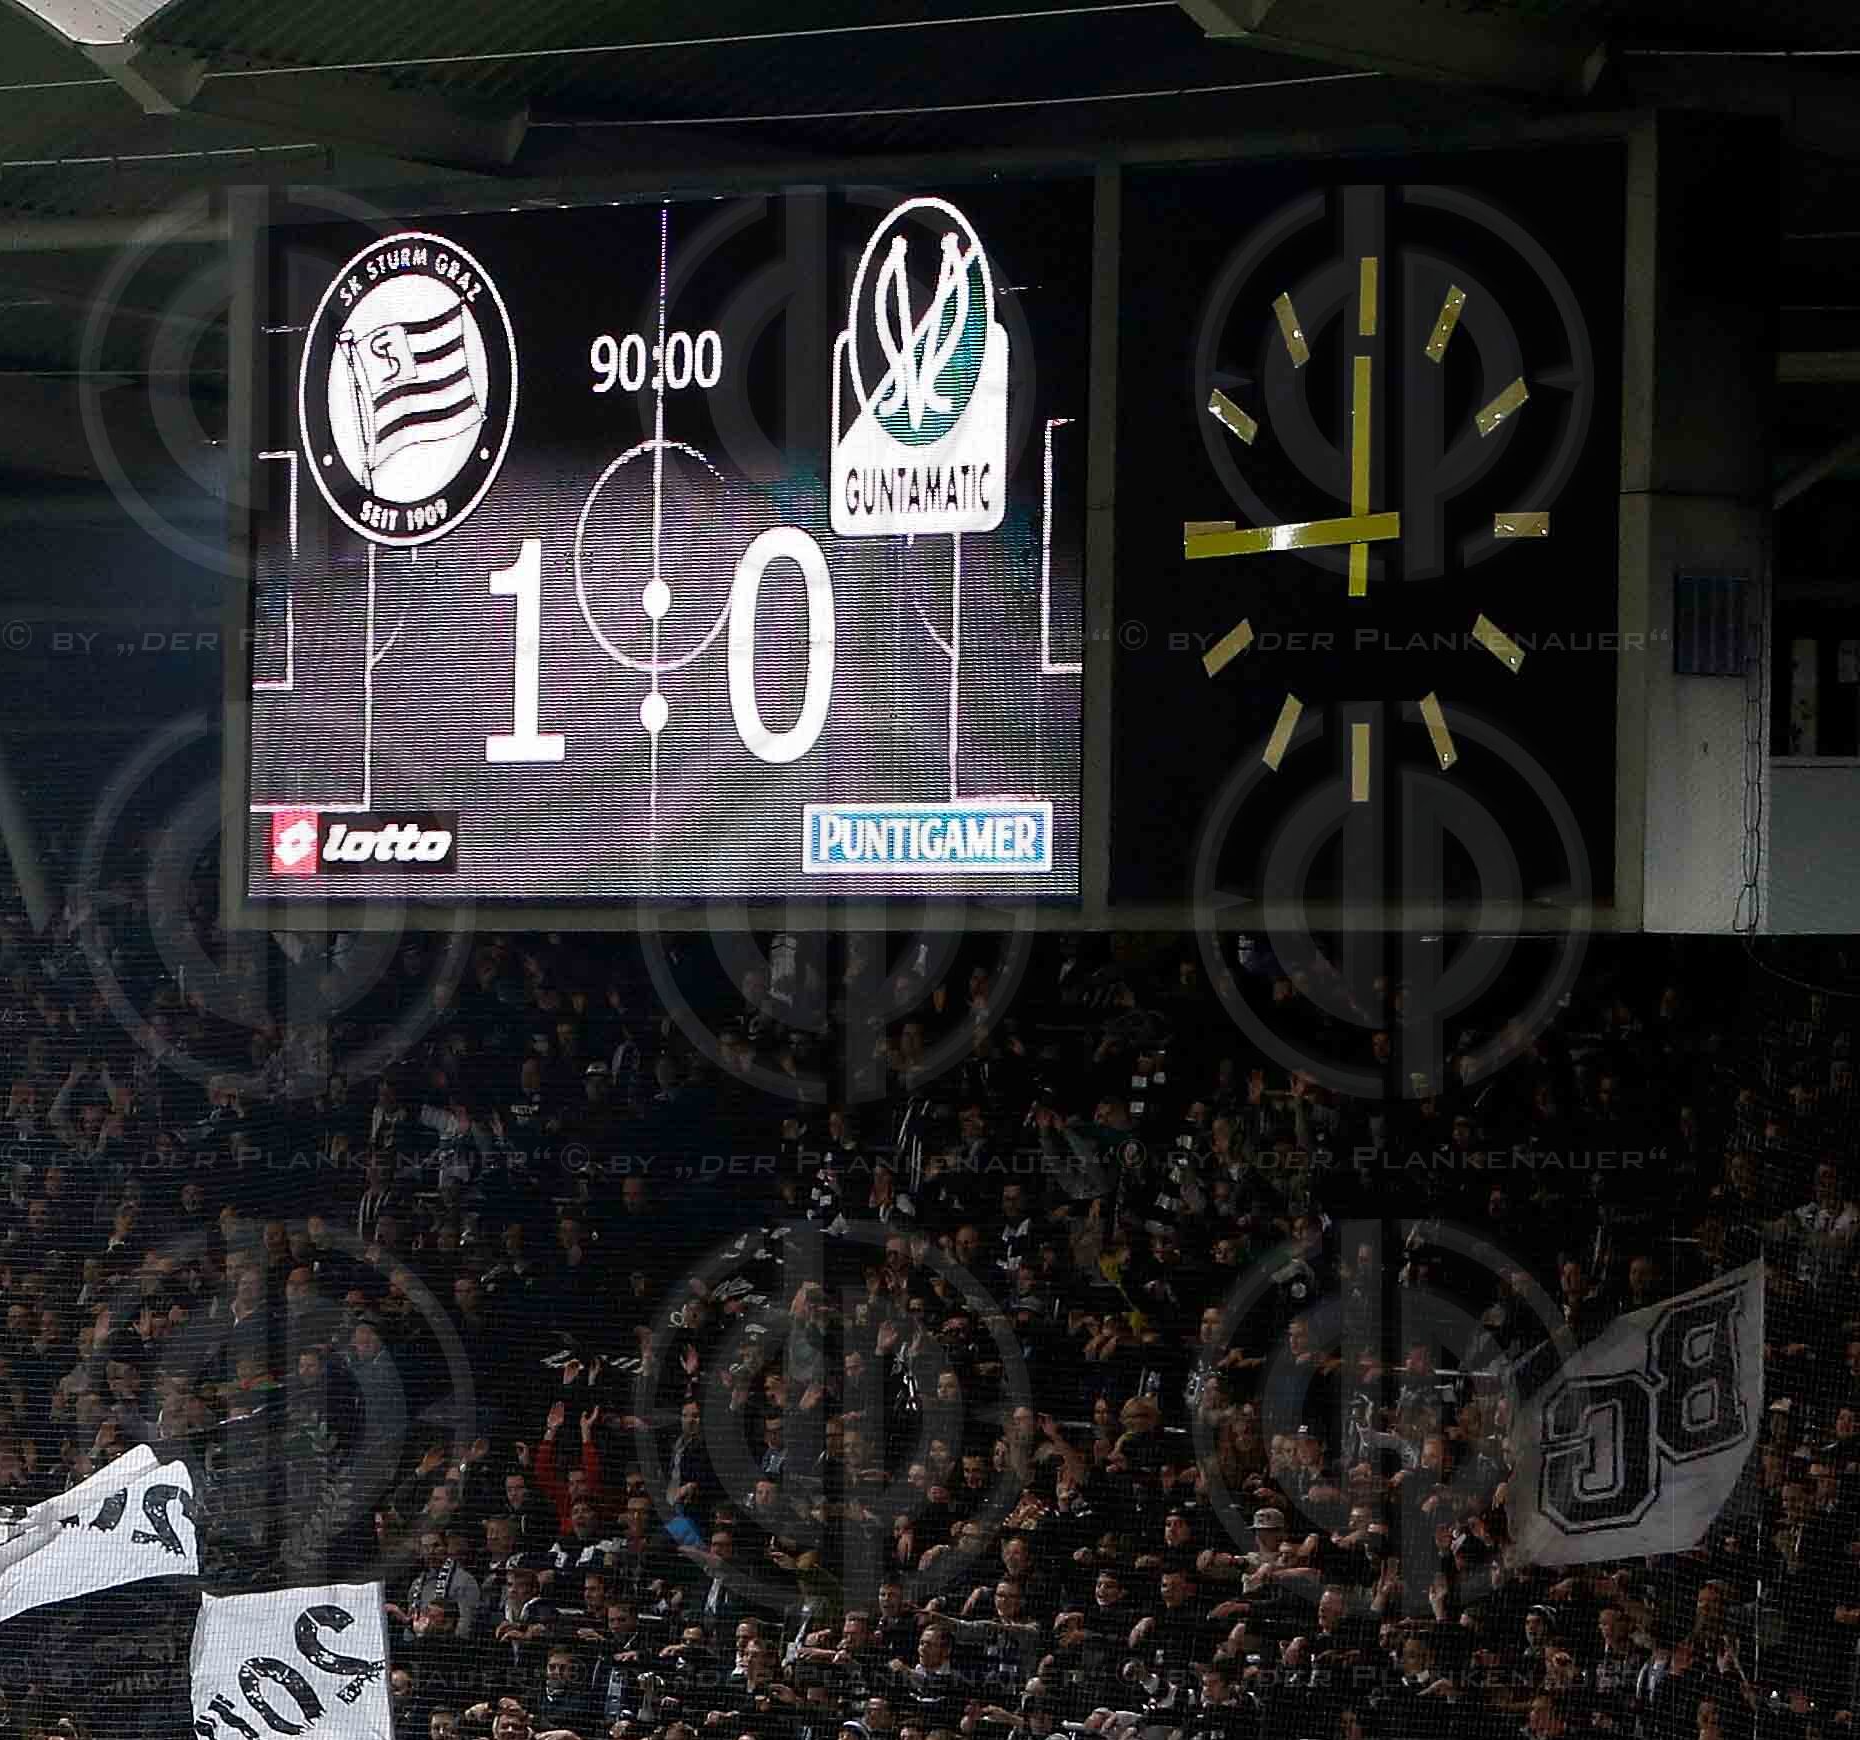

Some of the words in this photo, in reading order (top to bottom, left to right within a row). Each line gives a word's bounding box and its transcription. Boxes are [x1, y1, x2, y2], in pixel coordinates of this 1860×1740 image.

[340, 276, 364, 307] SK
[366, 248, 429, 280] STURM
[435, 253, 482, 303] GRAZ
[590, 331, 723, 392] 90:00
[359, 500, 398, 531] SEIT
[407, 498, 448, 532] 1909
[842, 465, 991, 517] GUNTAMATIC
[485, 539, 566, 763] 1
[727, 525, 836, 763] 0
[322, 818, 452, 862] lotto
[817, 812, 1033, 862] PUNTIGAMER
